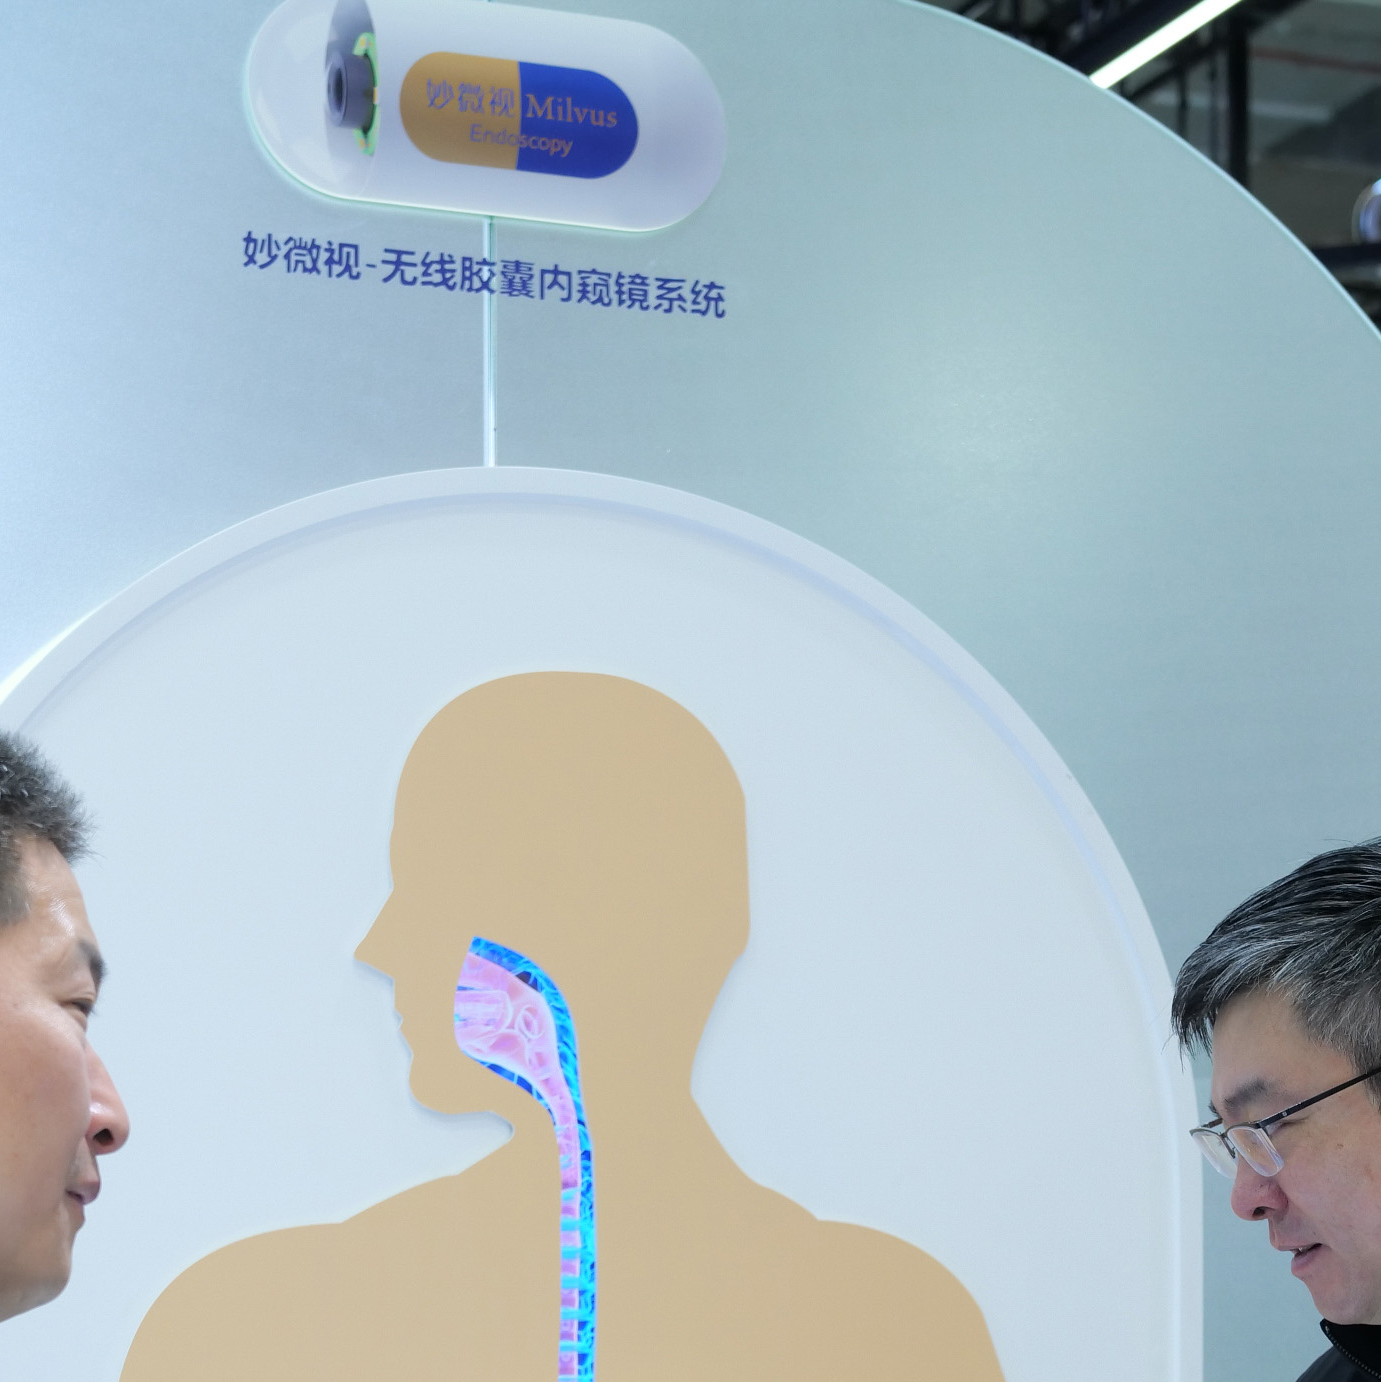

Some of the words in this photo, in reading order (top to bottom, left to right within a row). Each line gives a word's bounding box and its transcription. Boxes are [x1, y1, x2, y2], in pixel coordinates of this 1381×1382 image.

[426, 78, 516, 119] 妙微视
[525, 93, 619, 128] Milvus
[469, 123, 573, 158] Endoscopy
[242, 230, 727, 319] 妙微视-无线胶囊内窥镜系统
